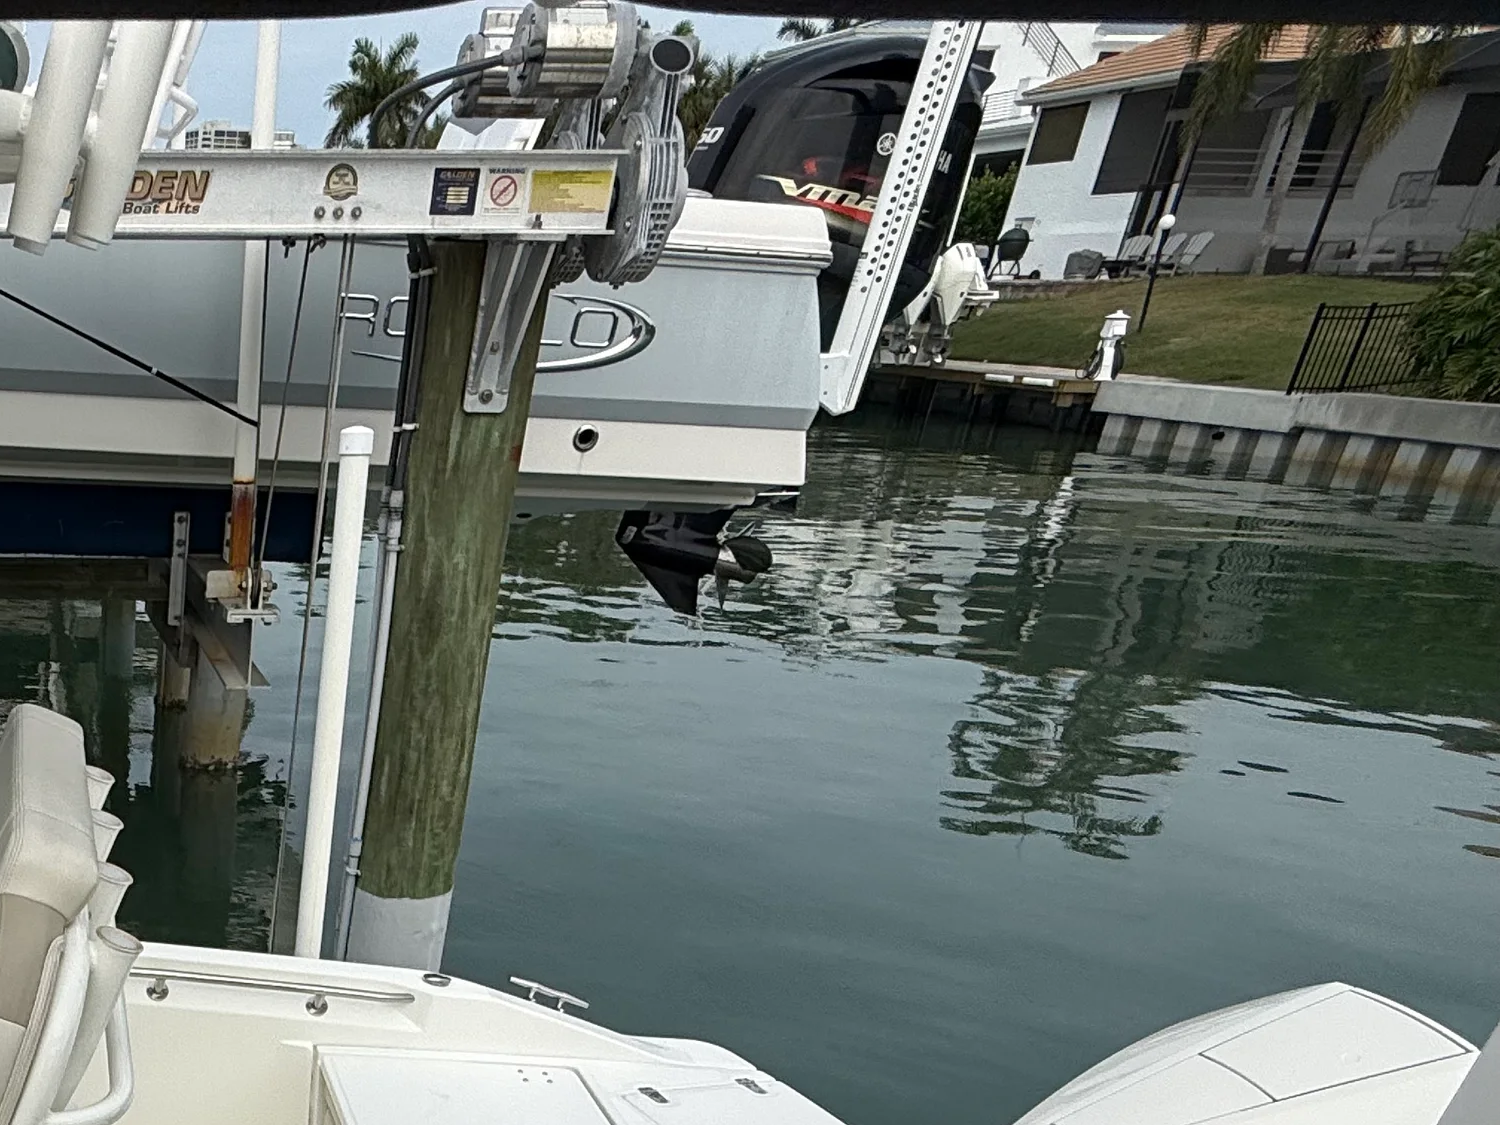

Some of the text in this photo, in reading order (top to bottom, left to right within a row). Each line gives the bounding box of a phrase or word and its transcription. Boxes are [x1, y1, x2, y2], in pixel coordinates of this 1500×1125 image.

[488, 167, 526, 175] WARNING
[122, 201, 201, 215] Boat Lifts
